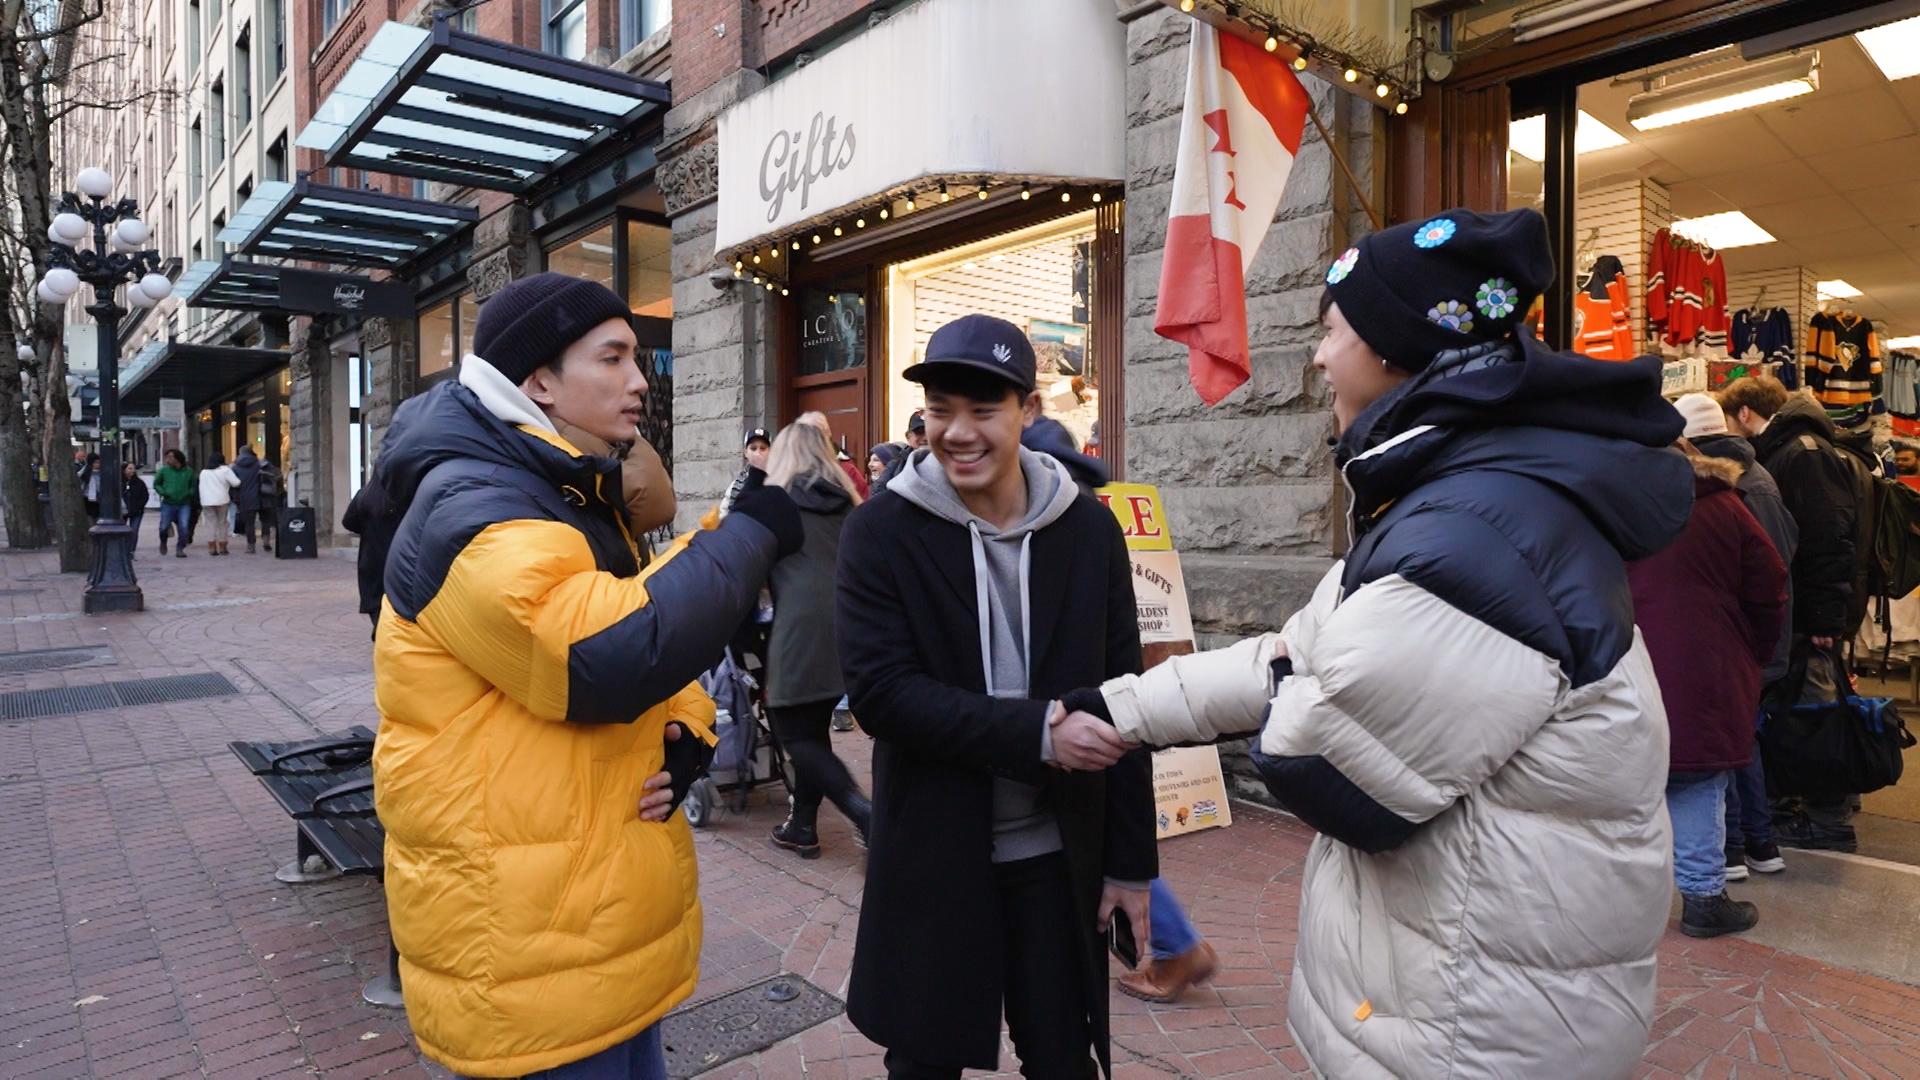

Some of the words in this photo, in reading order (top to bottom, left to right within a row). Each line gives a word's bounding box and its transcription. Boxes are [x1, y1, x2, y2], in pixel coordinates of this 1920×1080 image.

[759, 111, 857, 223] Gifts
[1145, 567, 1173, 594] GIFTS
[1138, 620, 1163, 632] SHOP
